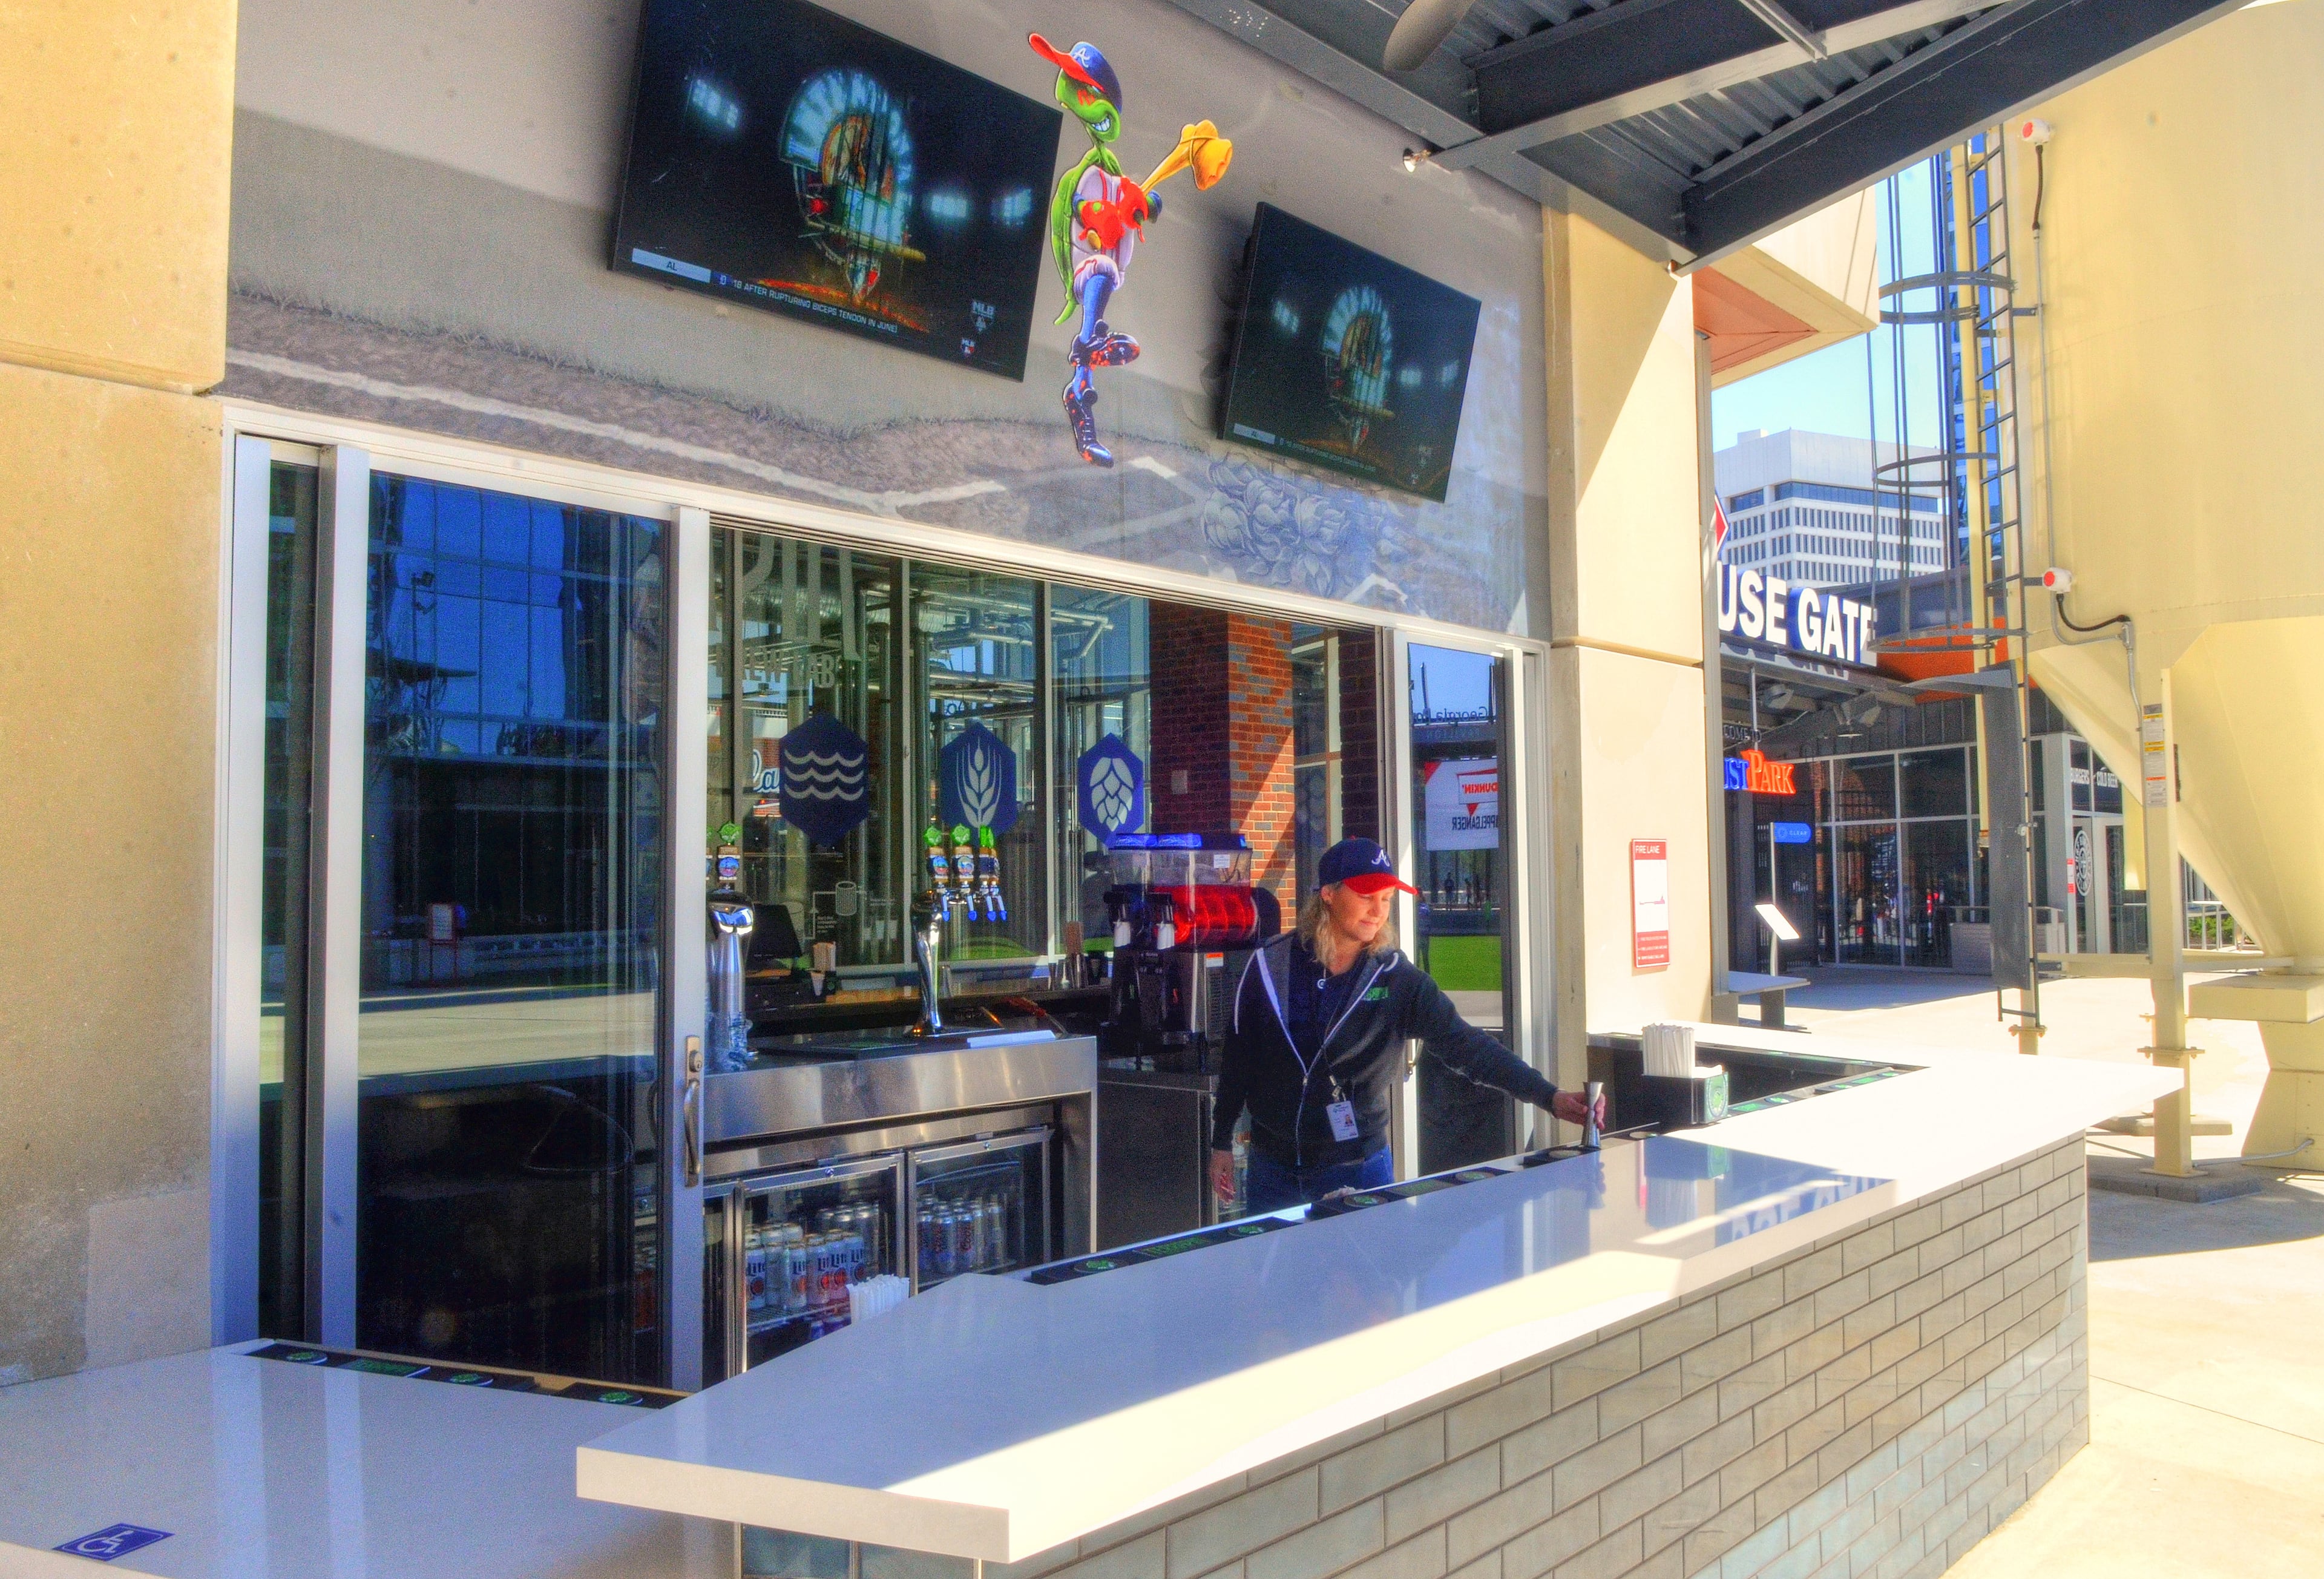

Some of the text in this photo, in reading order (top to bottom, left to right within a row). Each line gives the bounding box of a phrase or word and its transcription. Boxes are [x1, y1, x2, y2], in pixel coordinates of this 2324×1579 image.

[666, 261, 677, 271] AL
[744, 283, 767, 296] AFTER
[769, 289, 811, 309] RUPTURING
[812, 302, 838, 316] BICEPS
[838, 309, 867, 324] TENDON
[868, 318, 876, 327] IN
[1716, 560, 1787, 645] USE
[1371, 849, 1391, 867] A
[1635, 844, 1661, 854] FIRE LANE
